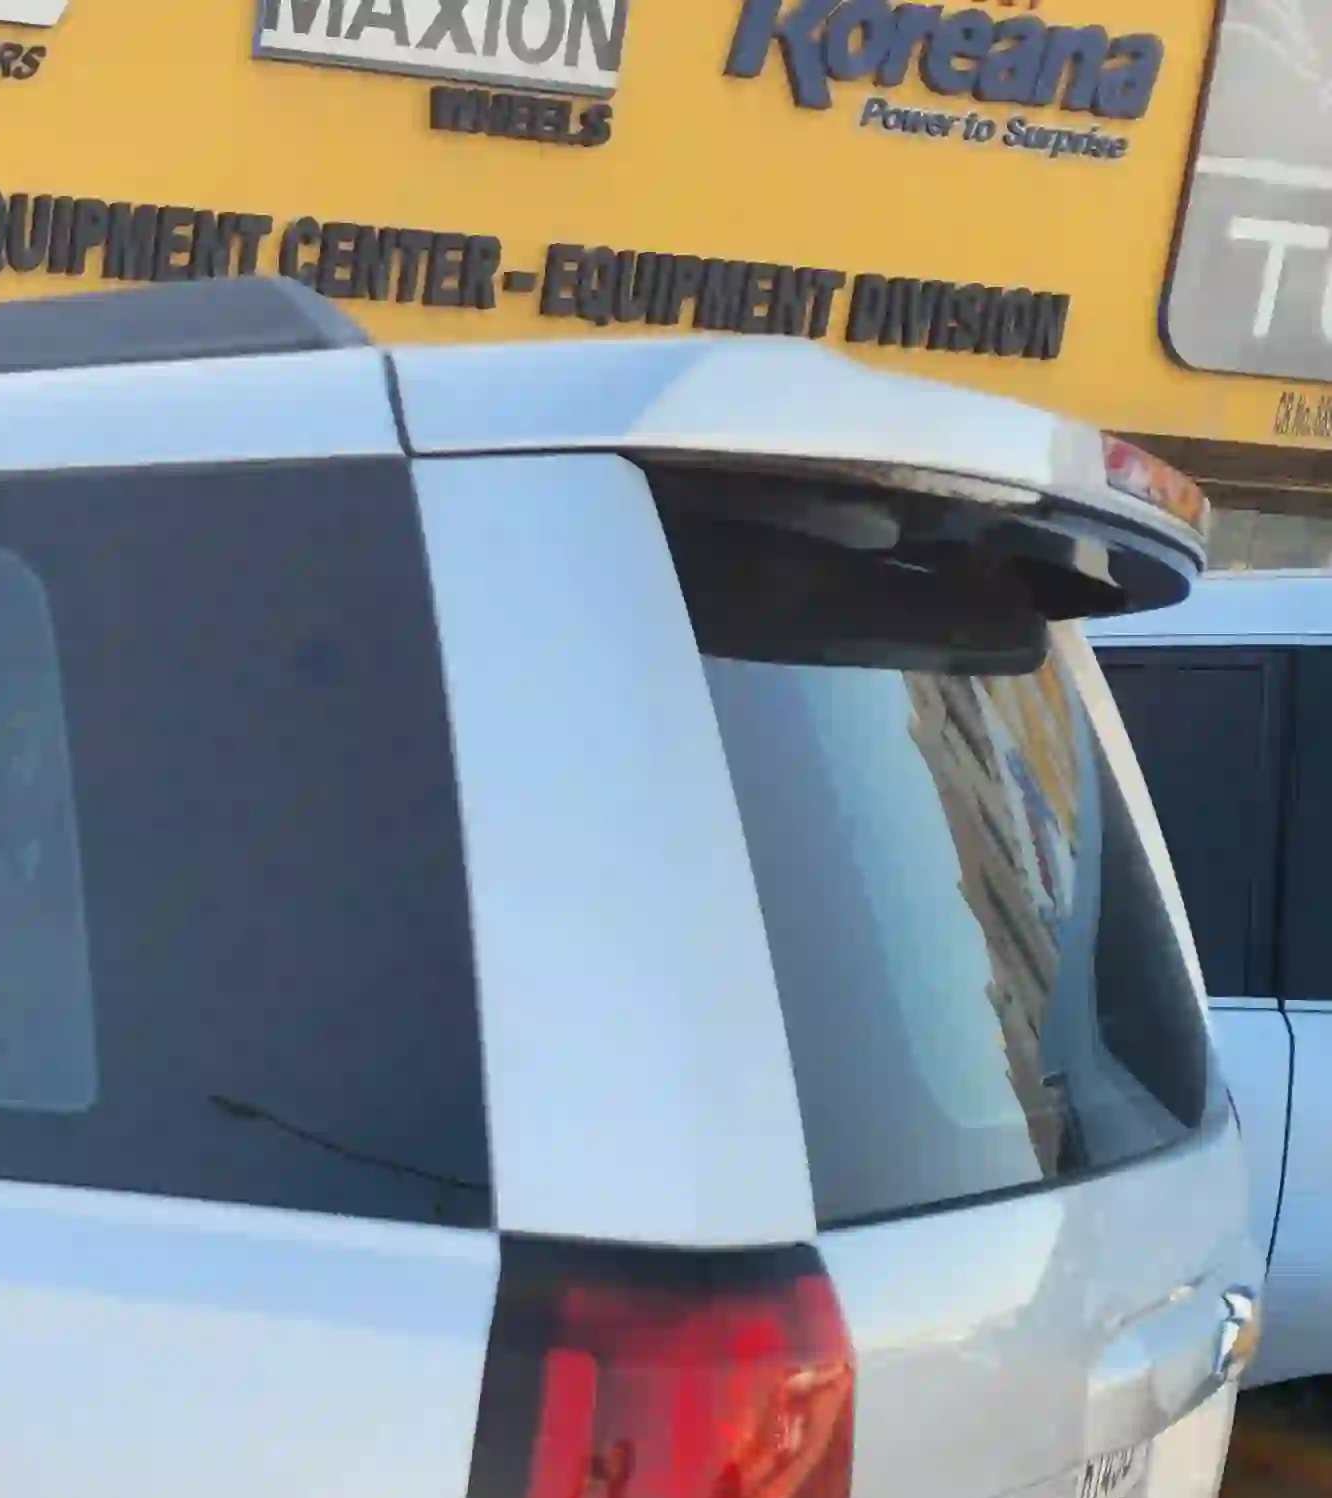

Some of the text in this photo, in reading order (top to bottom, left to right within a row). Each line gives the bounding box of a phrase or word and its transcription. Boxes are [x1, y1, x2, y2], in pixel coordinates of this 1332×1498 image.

[722, 0, 1164, 120] Koreana
[430, 86, 613, 147] WHEELS
[859, 97, 1129, 159] Power to Surprise
[845, 272, 1071, 361] DIVISION
